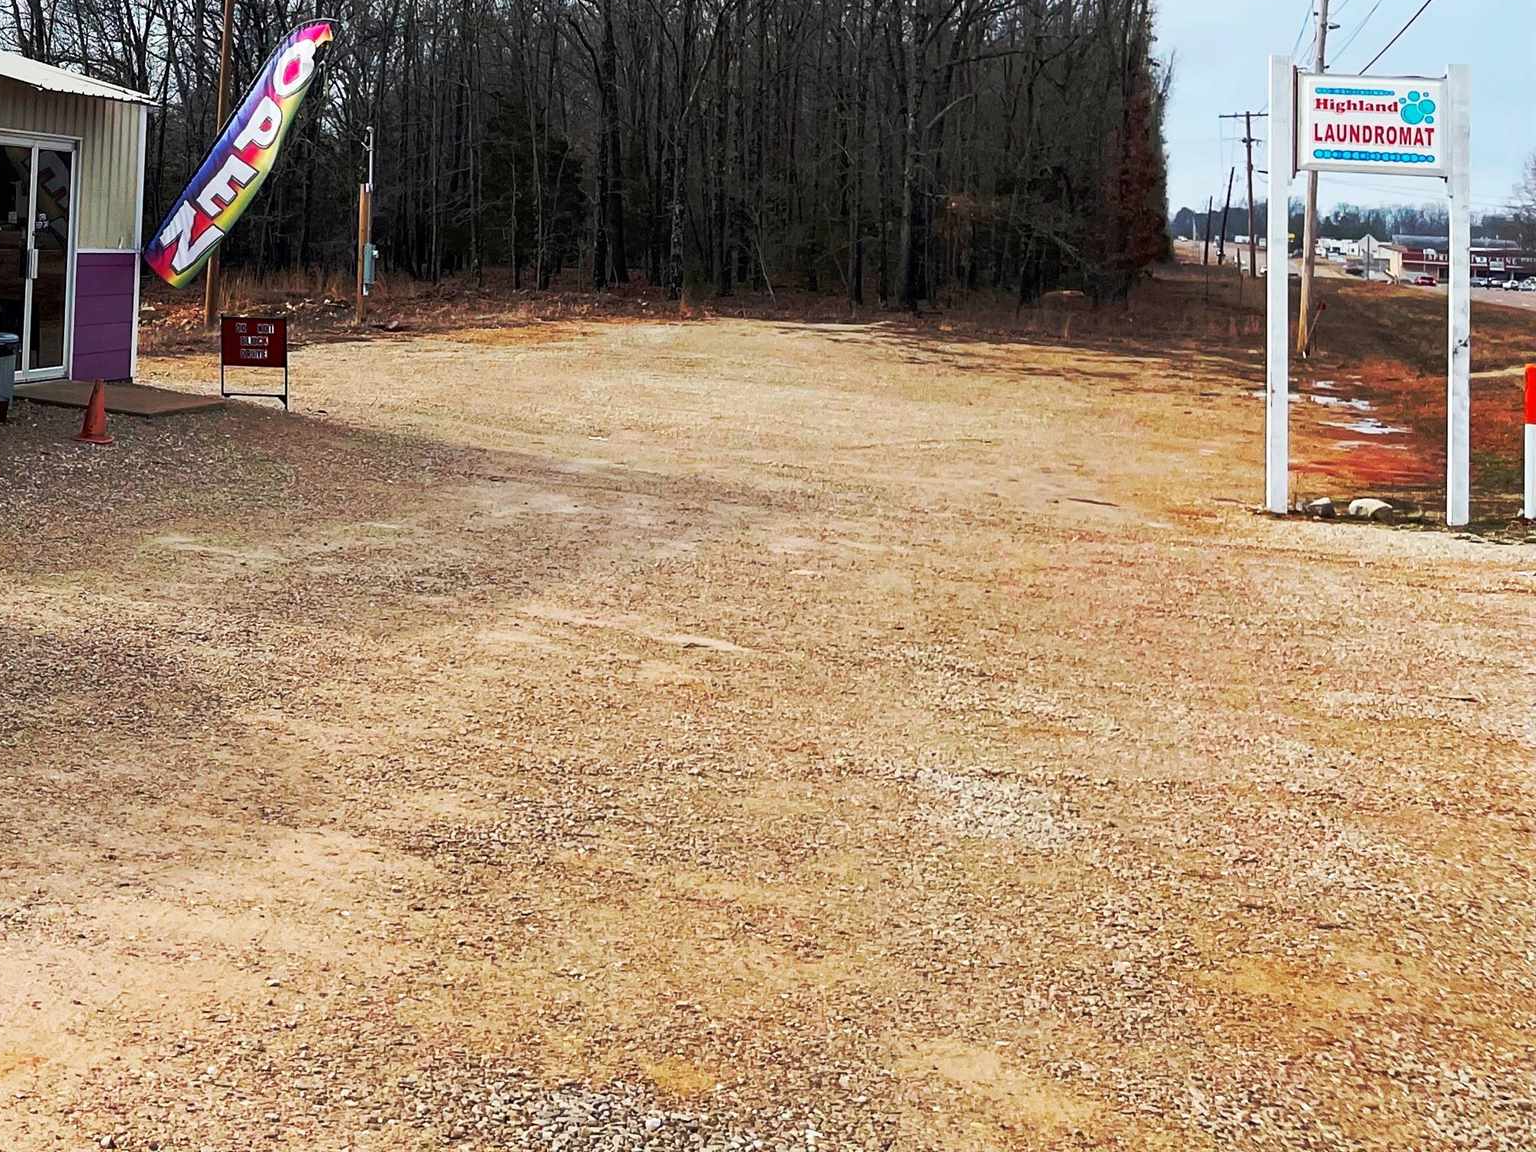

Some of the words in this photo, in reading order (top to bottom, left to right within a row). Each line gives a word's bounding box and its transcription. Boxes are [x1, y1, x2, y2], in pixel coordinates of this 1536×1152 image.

[1314, 98, 1398, 113] Highland
[1314, 123, 1435, 146] LAUNDROMAT
[159, 38, 315, 276] OPEN
